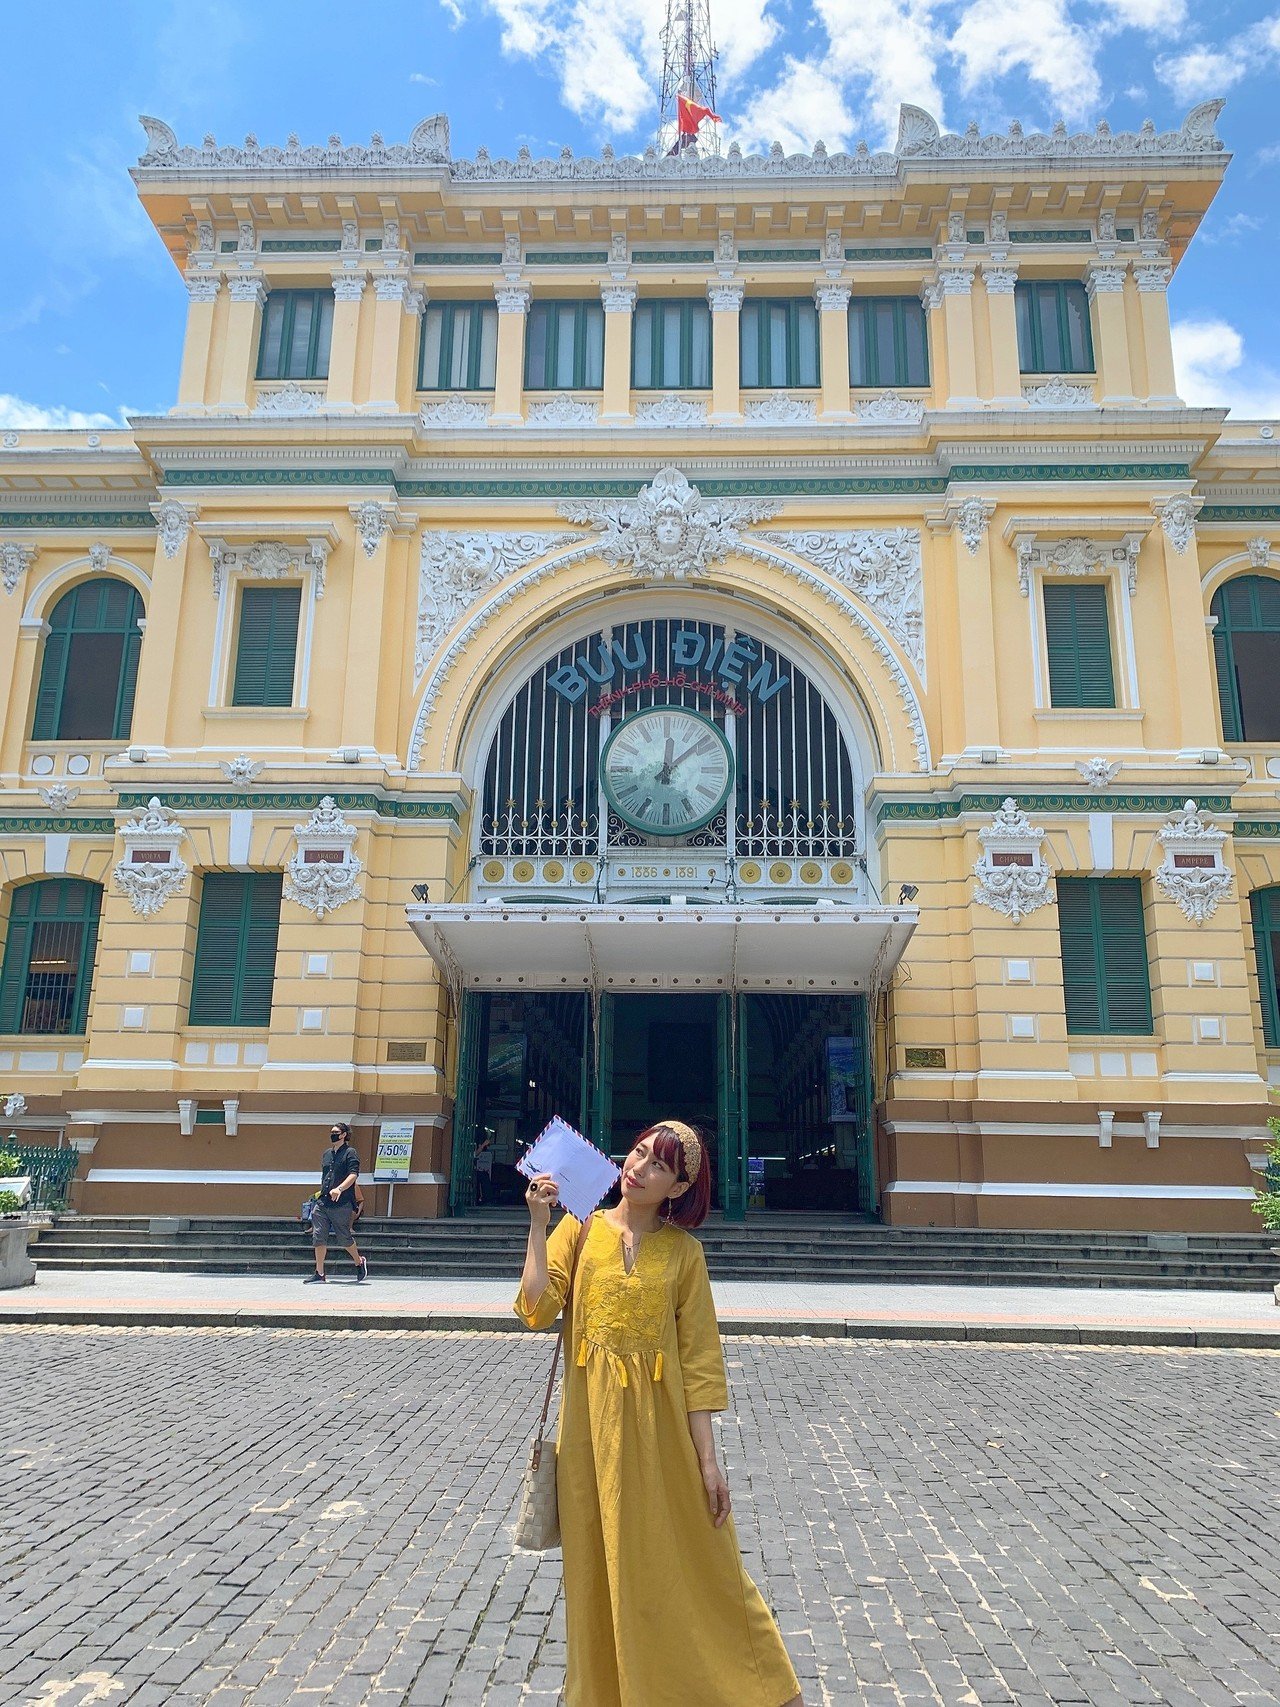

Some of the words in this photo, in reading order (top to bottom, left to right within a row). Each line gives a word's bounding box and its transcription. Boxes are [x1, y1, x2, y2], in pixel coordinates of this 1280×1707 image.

[671, 630, 790, 702] ĐIỆN
[664, 671, 687, 687] HỒ
[631, 866, 658, 878] 1886
[675, 866, 698, 878] 1891
